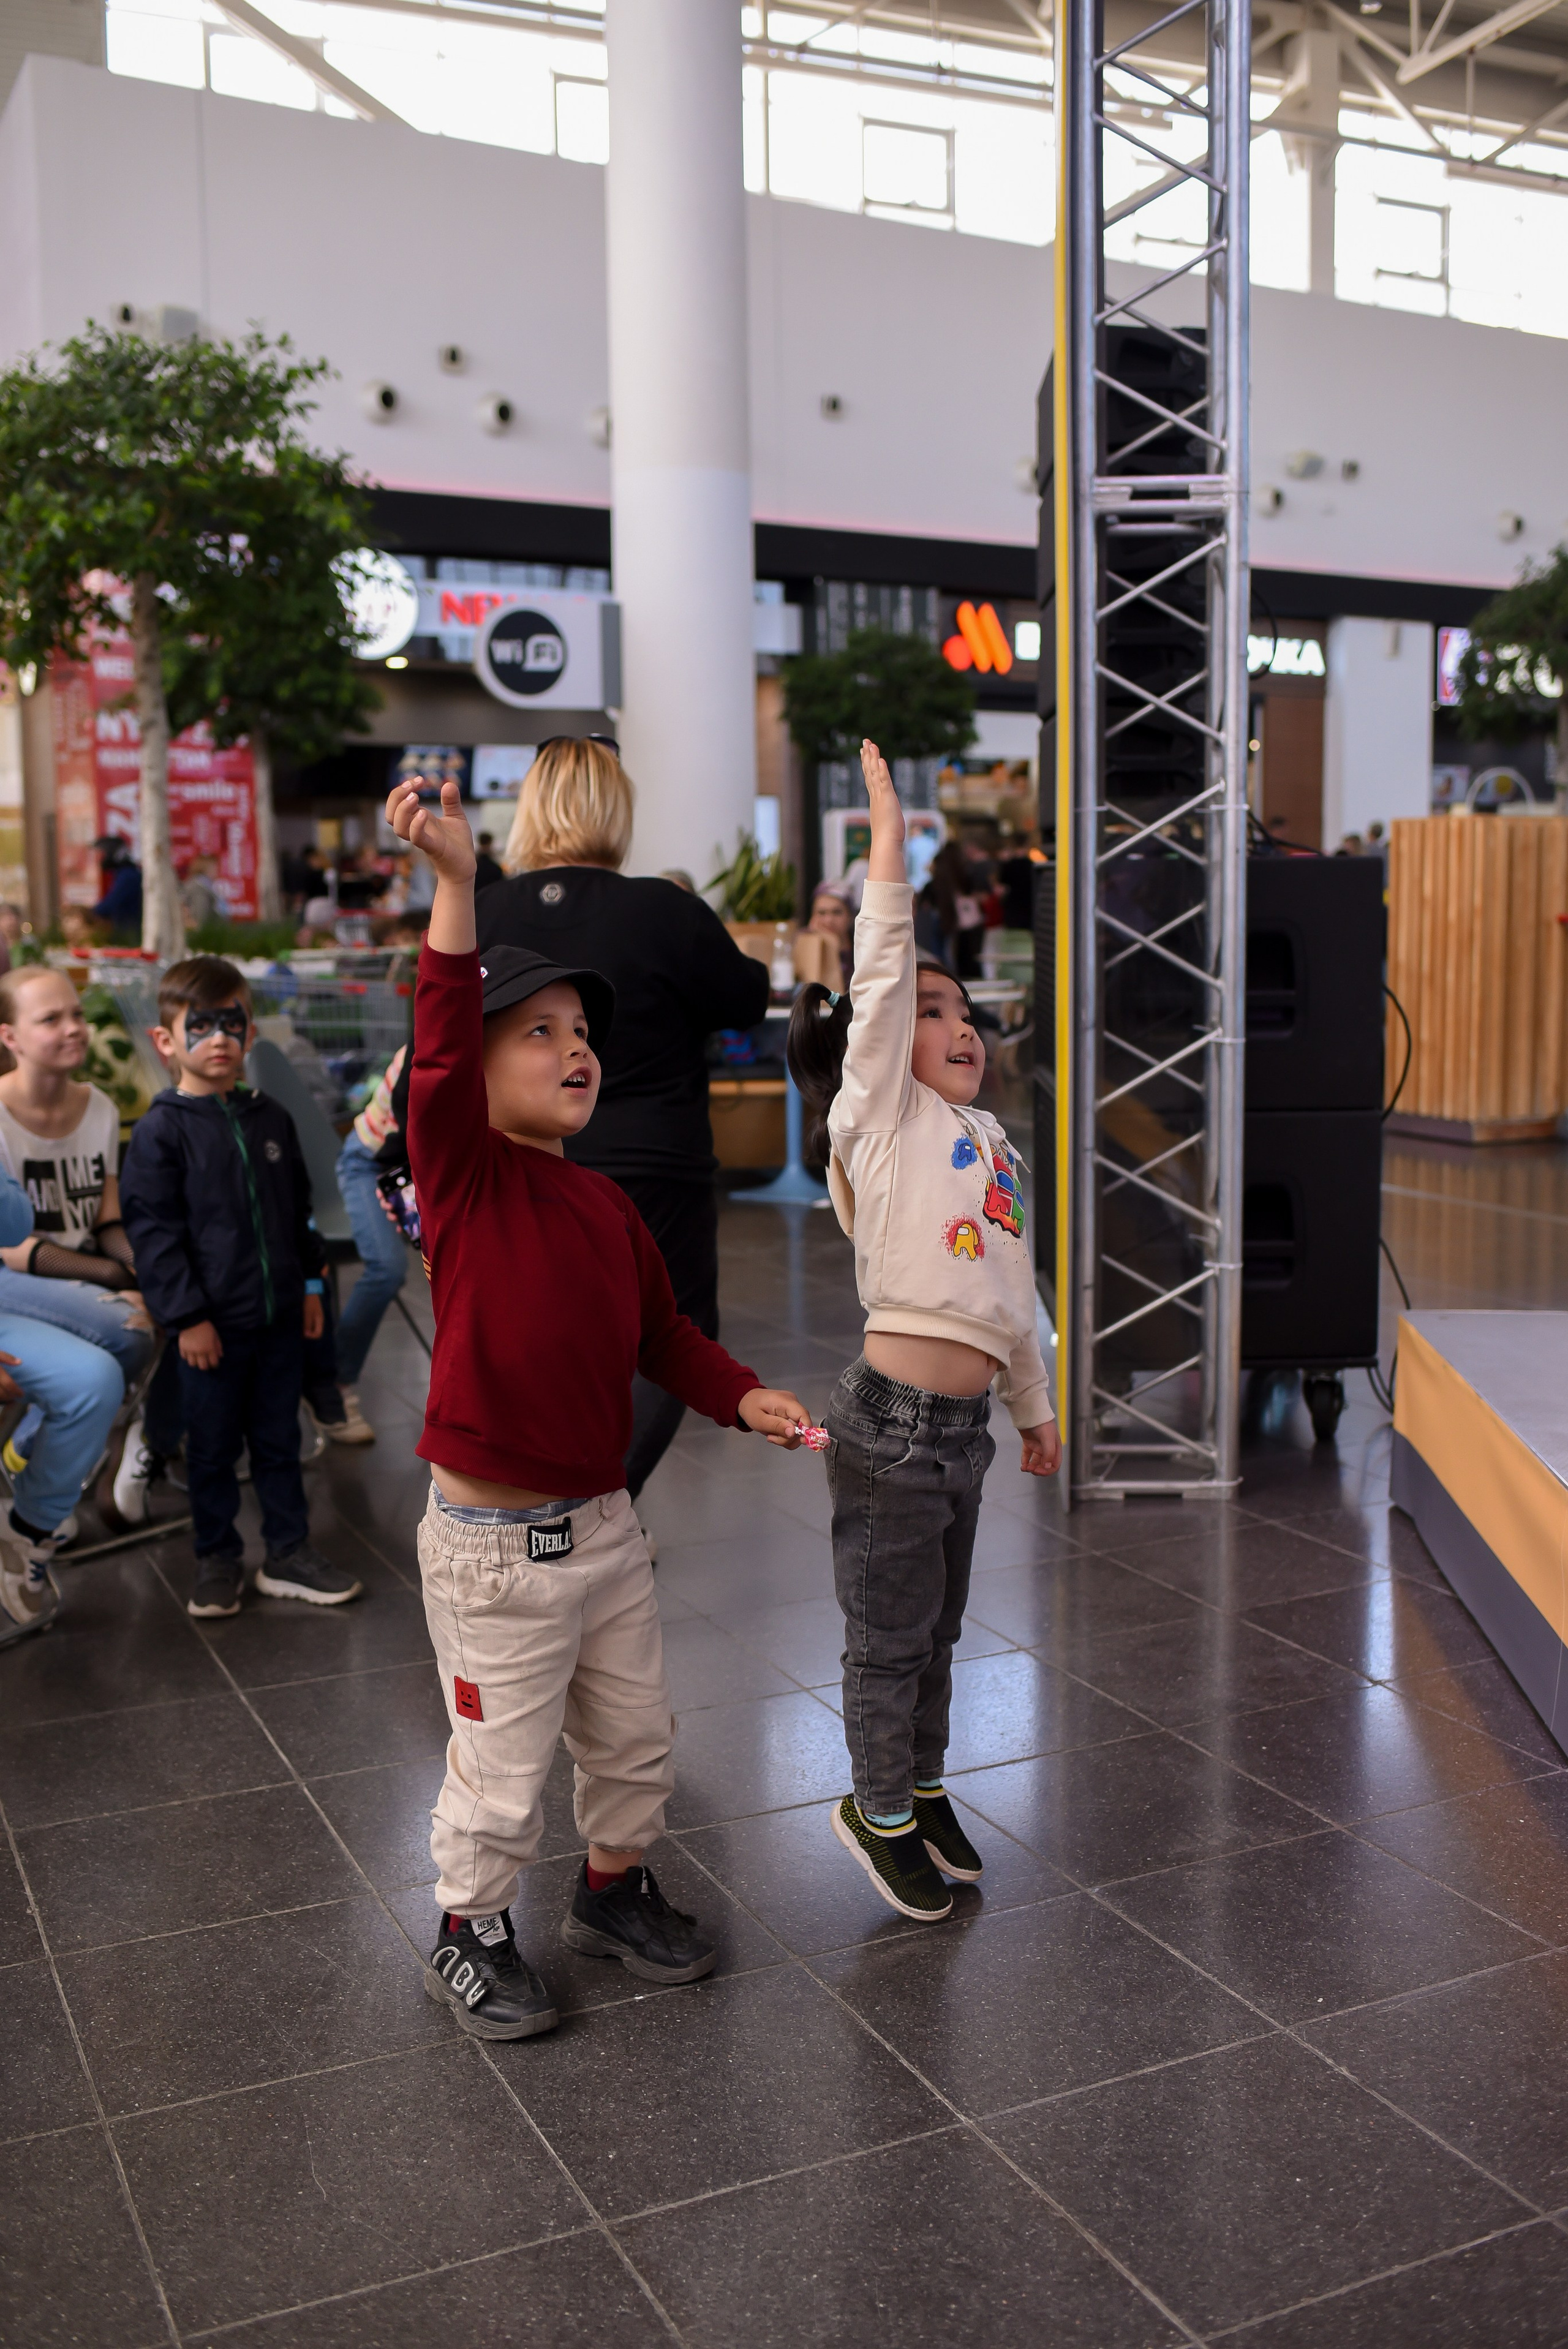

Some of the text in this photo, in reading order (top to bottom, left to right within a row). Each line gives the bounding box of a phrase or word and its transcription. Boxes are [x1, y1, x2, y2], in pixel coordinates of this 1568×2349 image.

[64, 1155, 104, 1190] ME
[65, 1195, 100, 1231] YO
[531, 1528, 571, 1558] EVERLA
